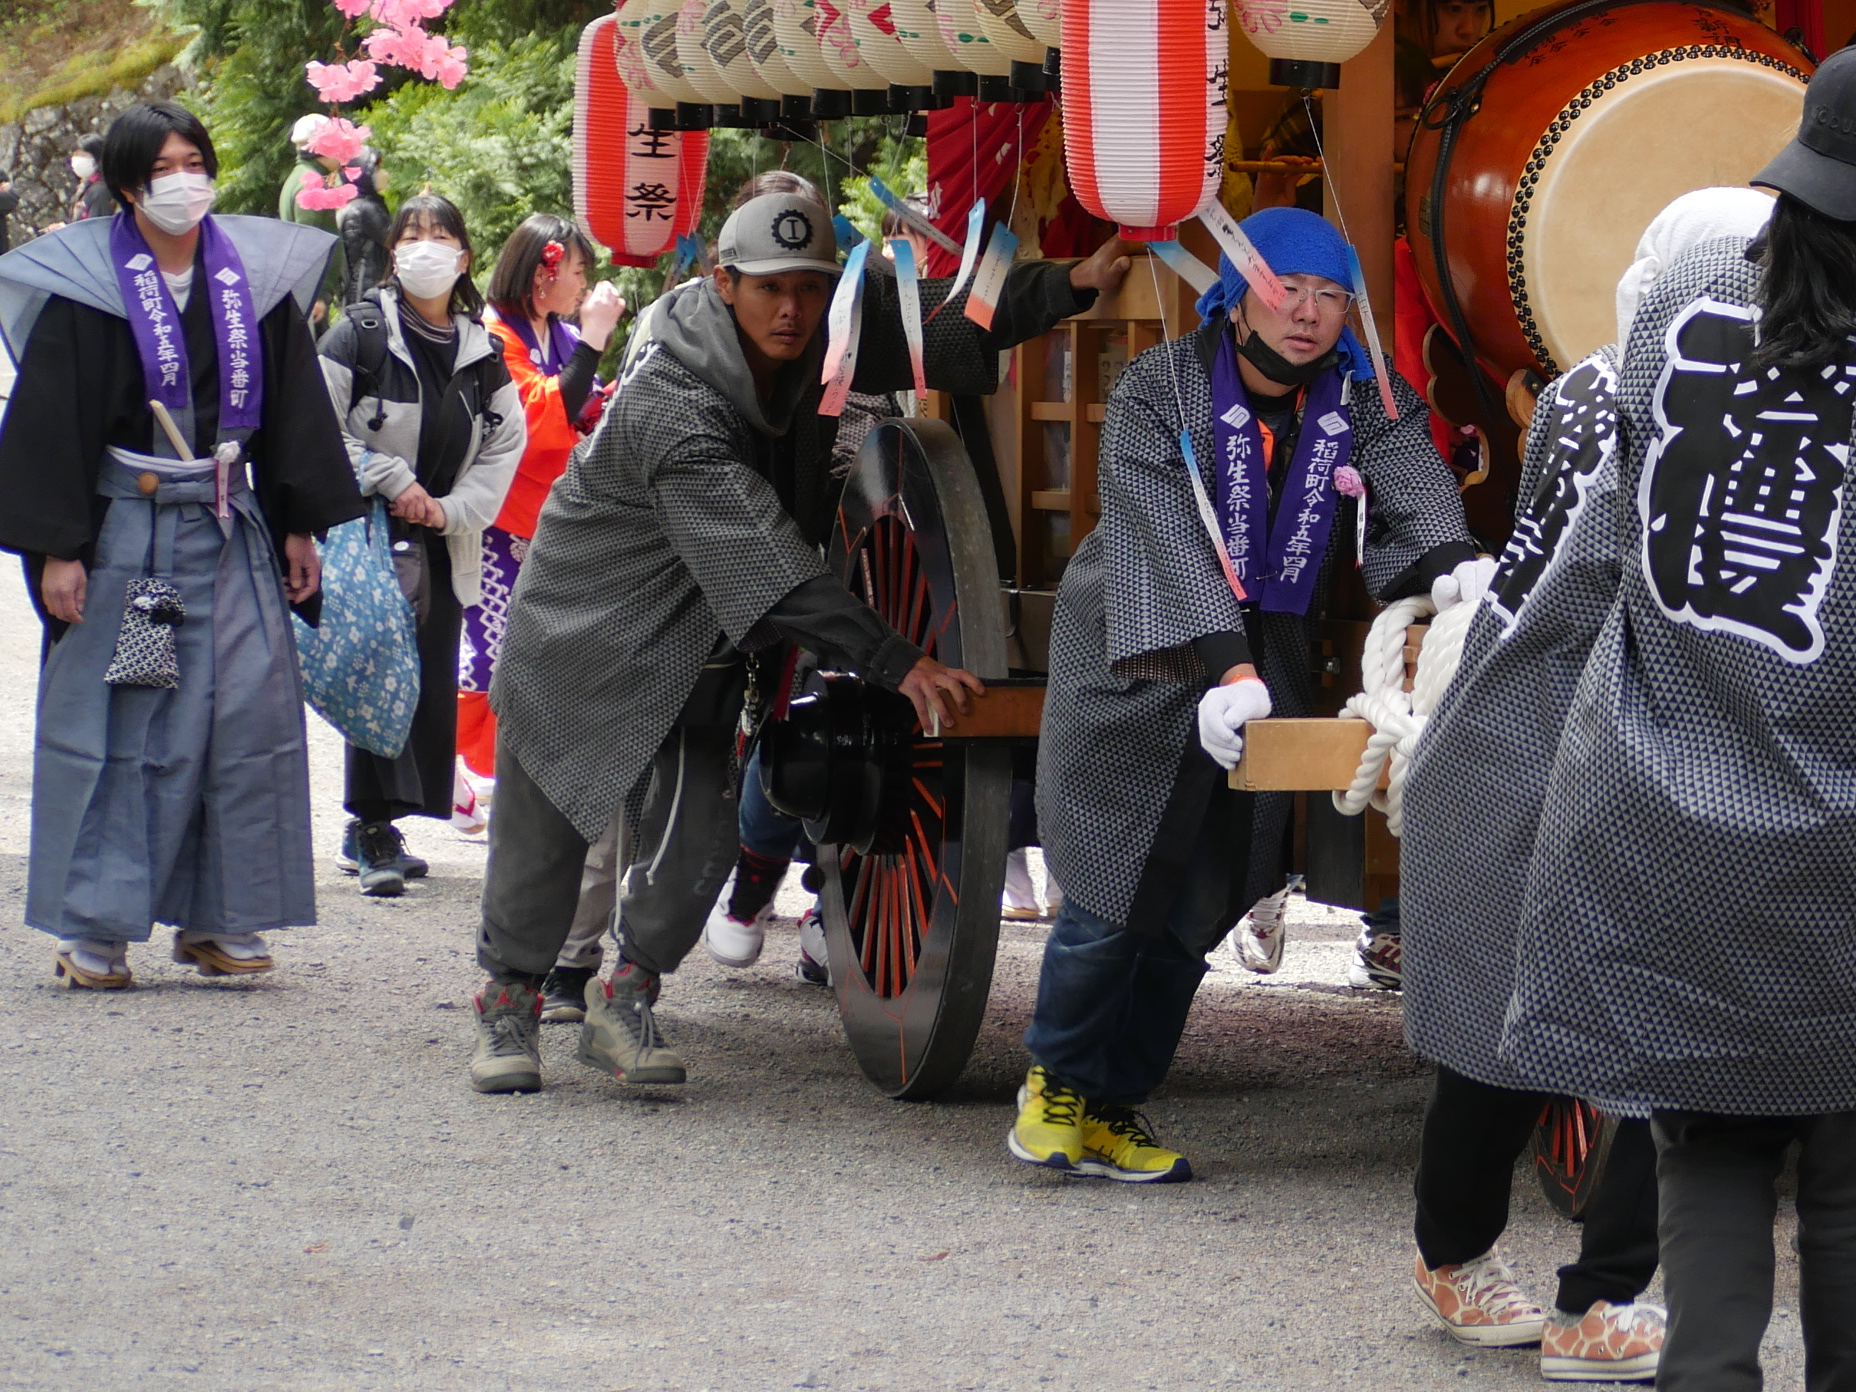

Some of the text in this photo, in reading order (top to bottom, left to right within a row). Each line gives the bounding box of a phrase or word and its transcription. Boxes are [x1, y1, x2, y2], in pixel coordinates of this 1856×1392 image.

[221, 288, 250, 409] 弥生祭当番町
[1279, 438, 1339, 584] 稲荷町令和五年四月
